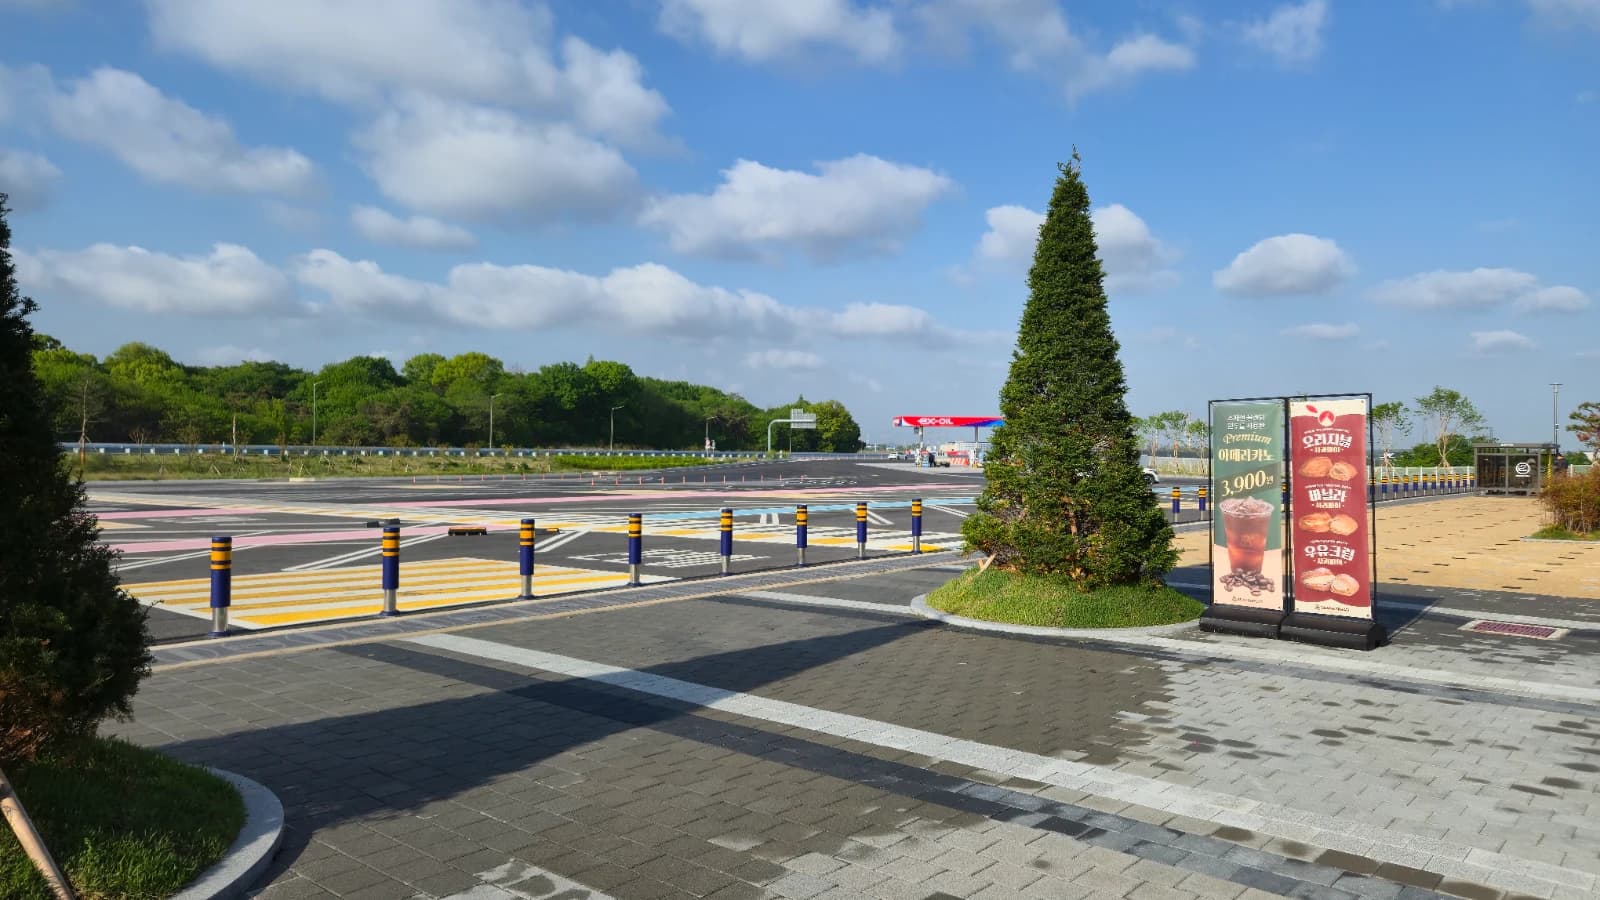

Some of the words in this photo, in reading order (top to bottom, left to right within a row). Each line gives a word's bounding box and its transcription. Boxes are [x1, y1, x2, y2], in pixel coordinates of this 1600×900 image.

[1222, 431, 1272, 445] Premium
[1302, 433, 1353, 449] 오리지널
[1218, 448, 1276, 462] 아메리카노
[1308, 488, 1348, 503] 바닐라
[1303, 544, 1356, 561] 우유크림
